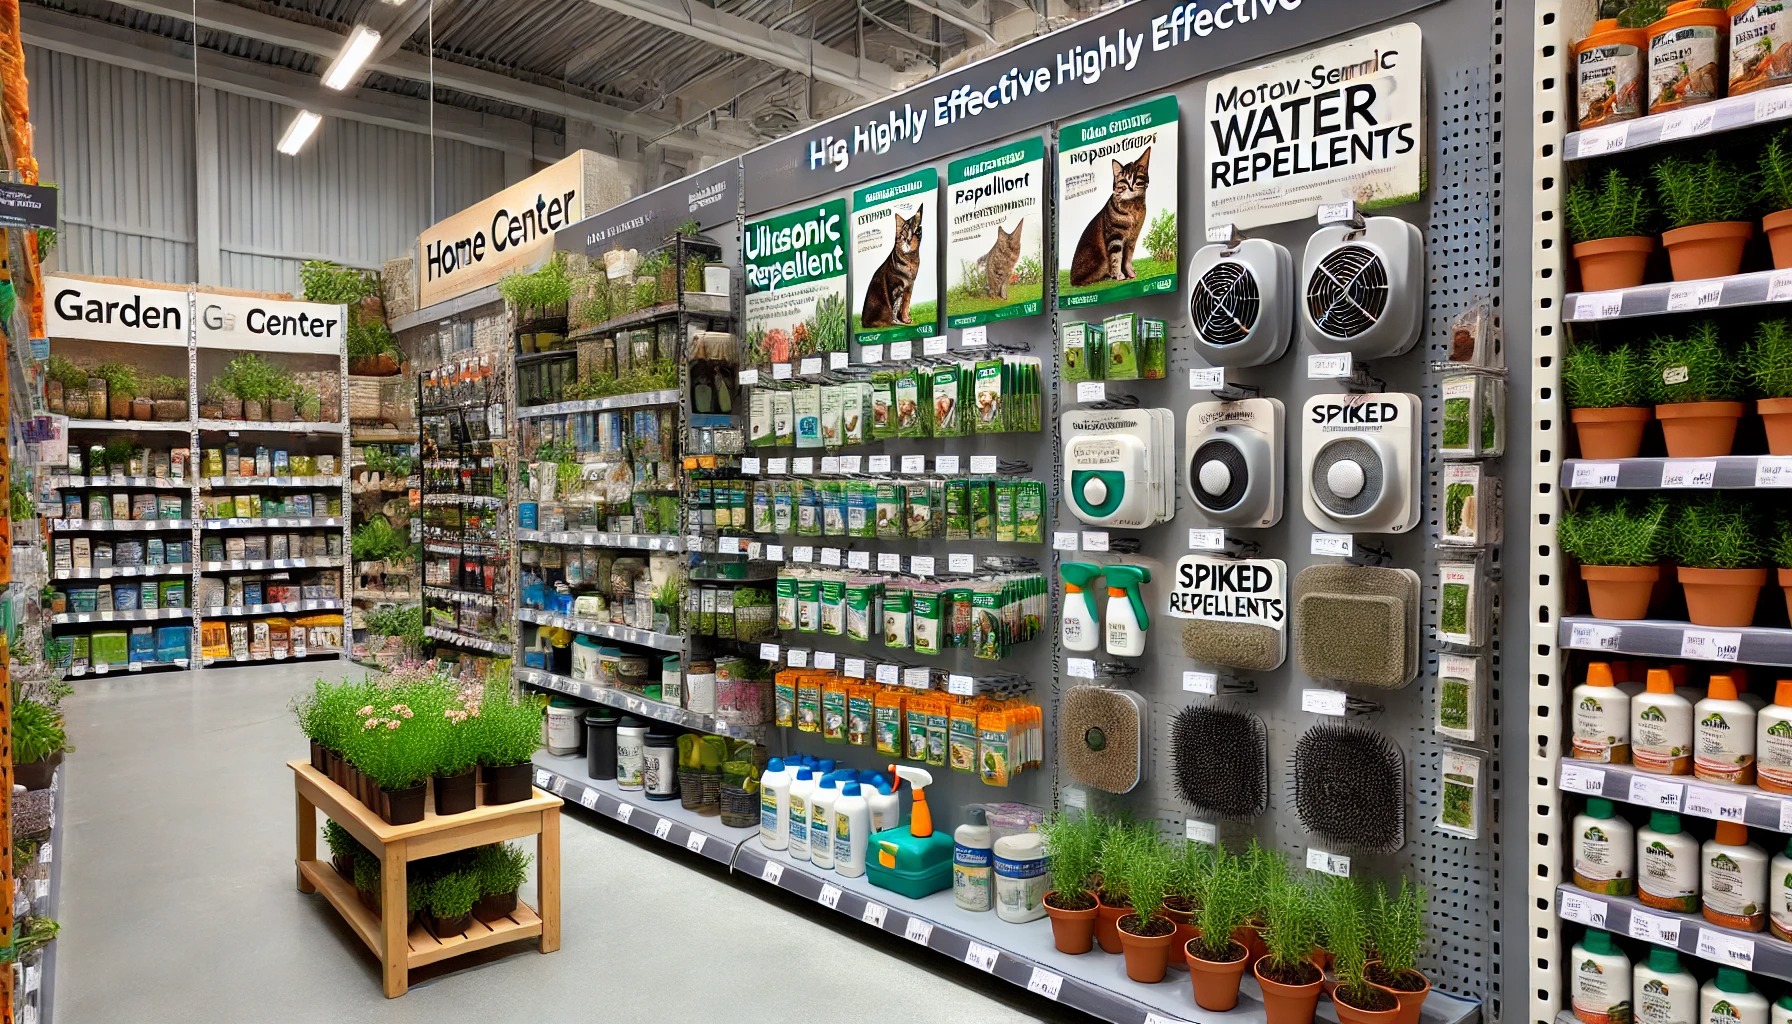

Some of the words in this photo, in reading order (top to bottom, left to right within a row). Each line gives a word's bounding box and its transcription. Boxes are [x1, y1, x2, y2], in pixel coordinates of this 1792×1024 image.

[854, 104, 928, 155] Highly
[934, 67, 1052, 128] Effective
[1056, 28, 1144, 85] Highly
[1211, 83, 1378, 157] WATER
[1211, 122, 1415, 189] REPELLENTS
[426, 231, 486, 282] Home
[491, 189, 575, 252] Center
[54, 289, 181, 330] Garden
[246, 308, 338, 338] Center
[1311, 402, 1399, 425] SPIKED
[1179, 563, 1273, 593] SPIKED
[1169, 592, 1284, 622] REPELLENTS
